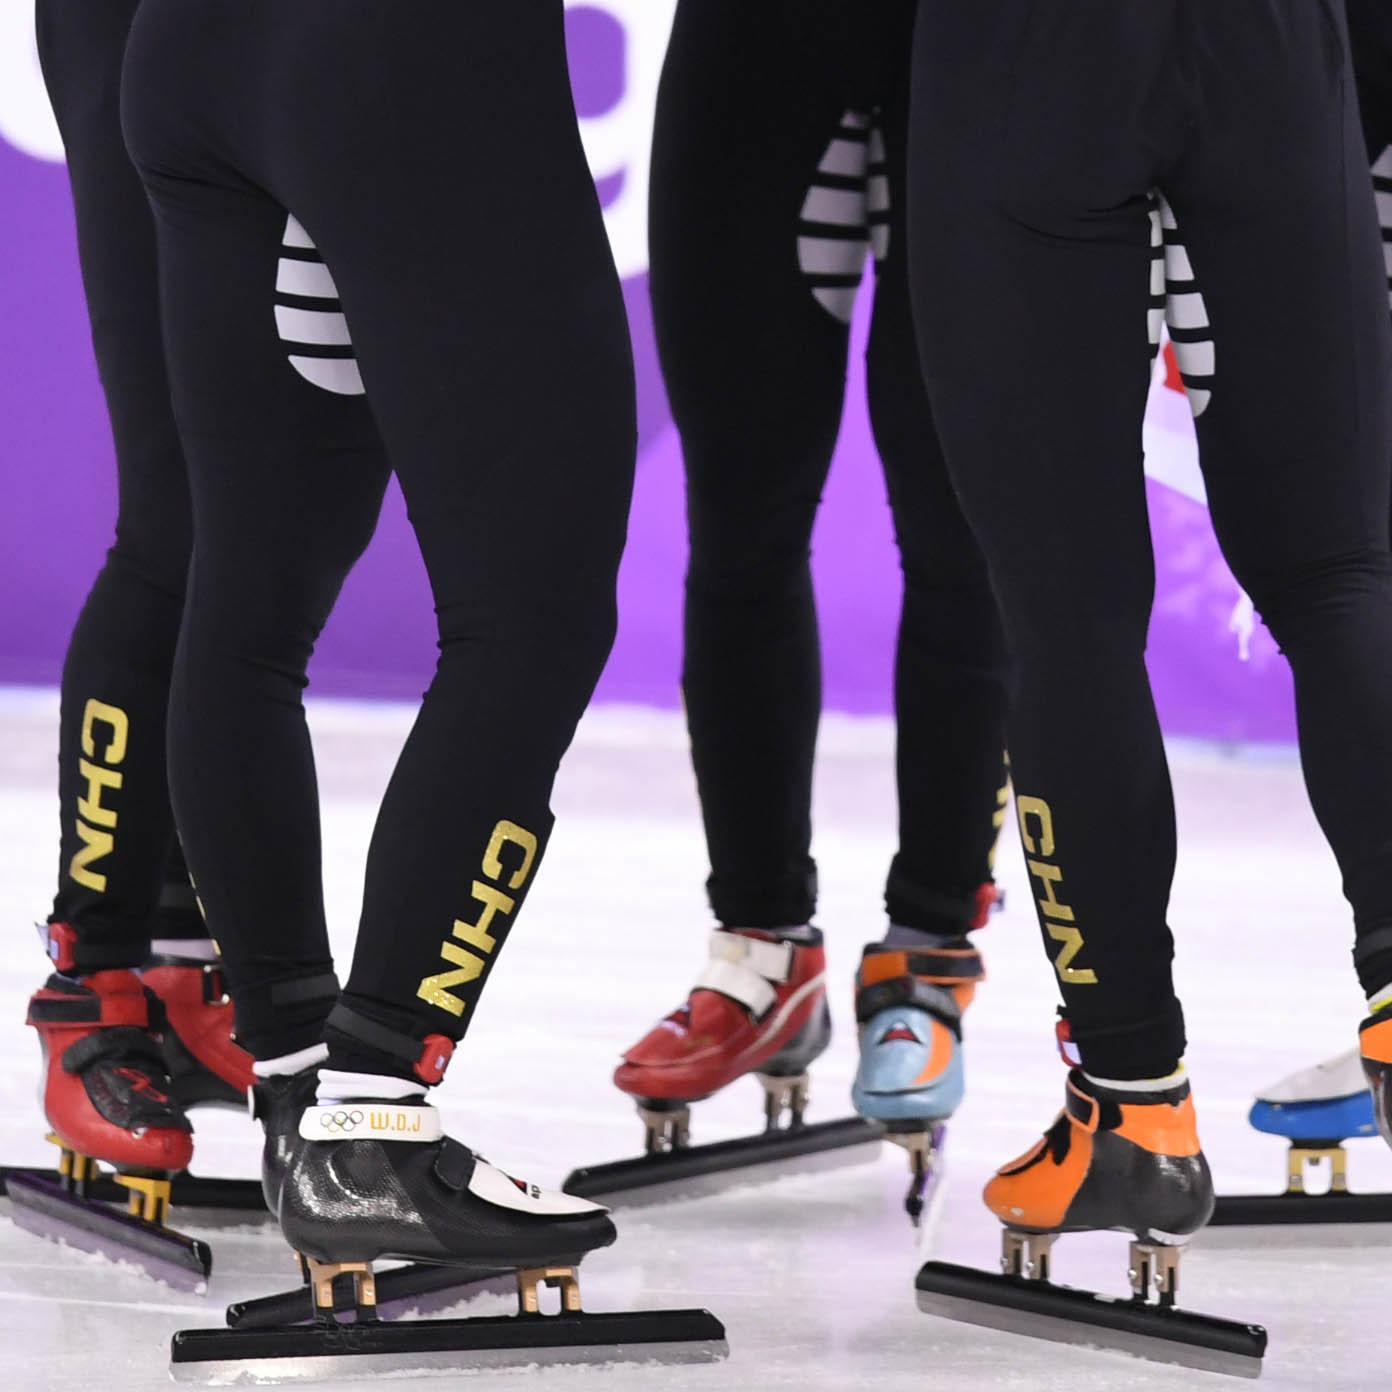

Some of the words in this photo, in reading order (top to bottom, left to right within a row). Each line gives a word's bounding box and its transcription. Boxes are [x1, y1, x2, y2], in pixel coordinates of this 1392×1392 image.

[72, 698, 128, 893] CHN
[1017, 795, 1098, 984] CHN
[416, 819, 538, 1017] CHN
